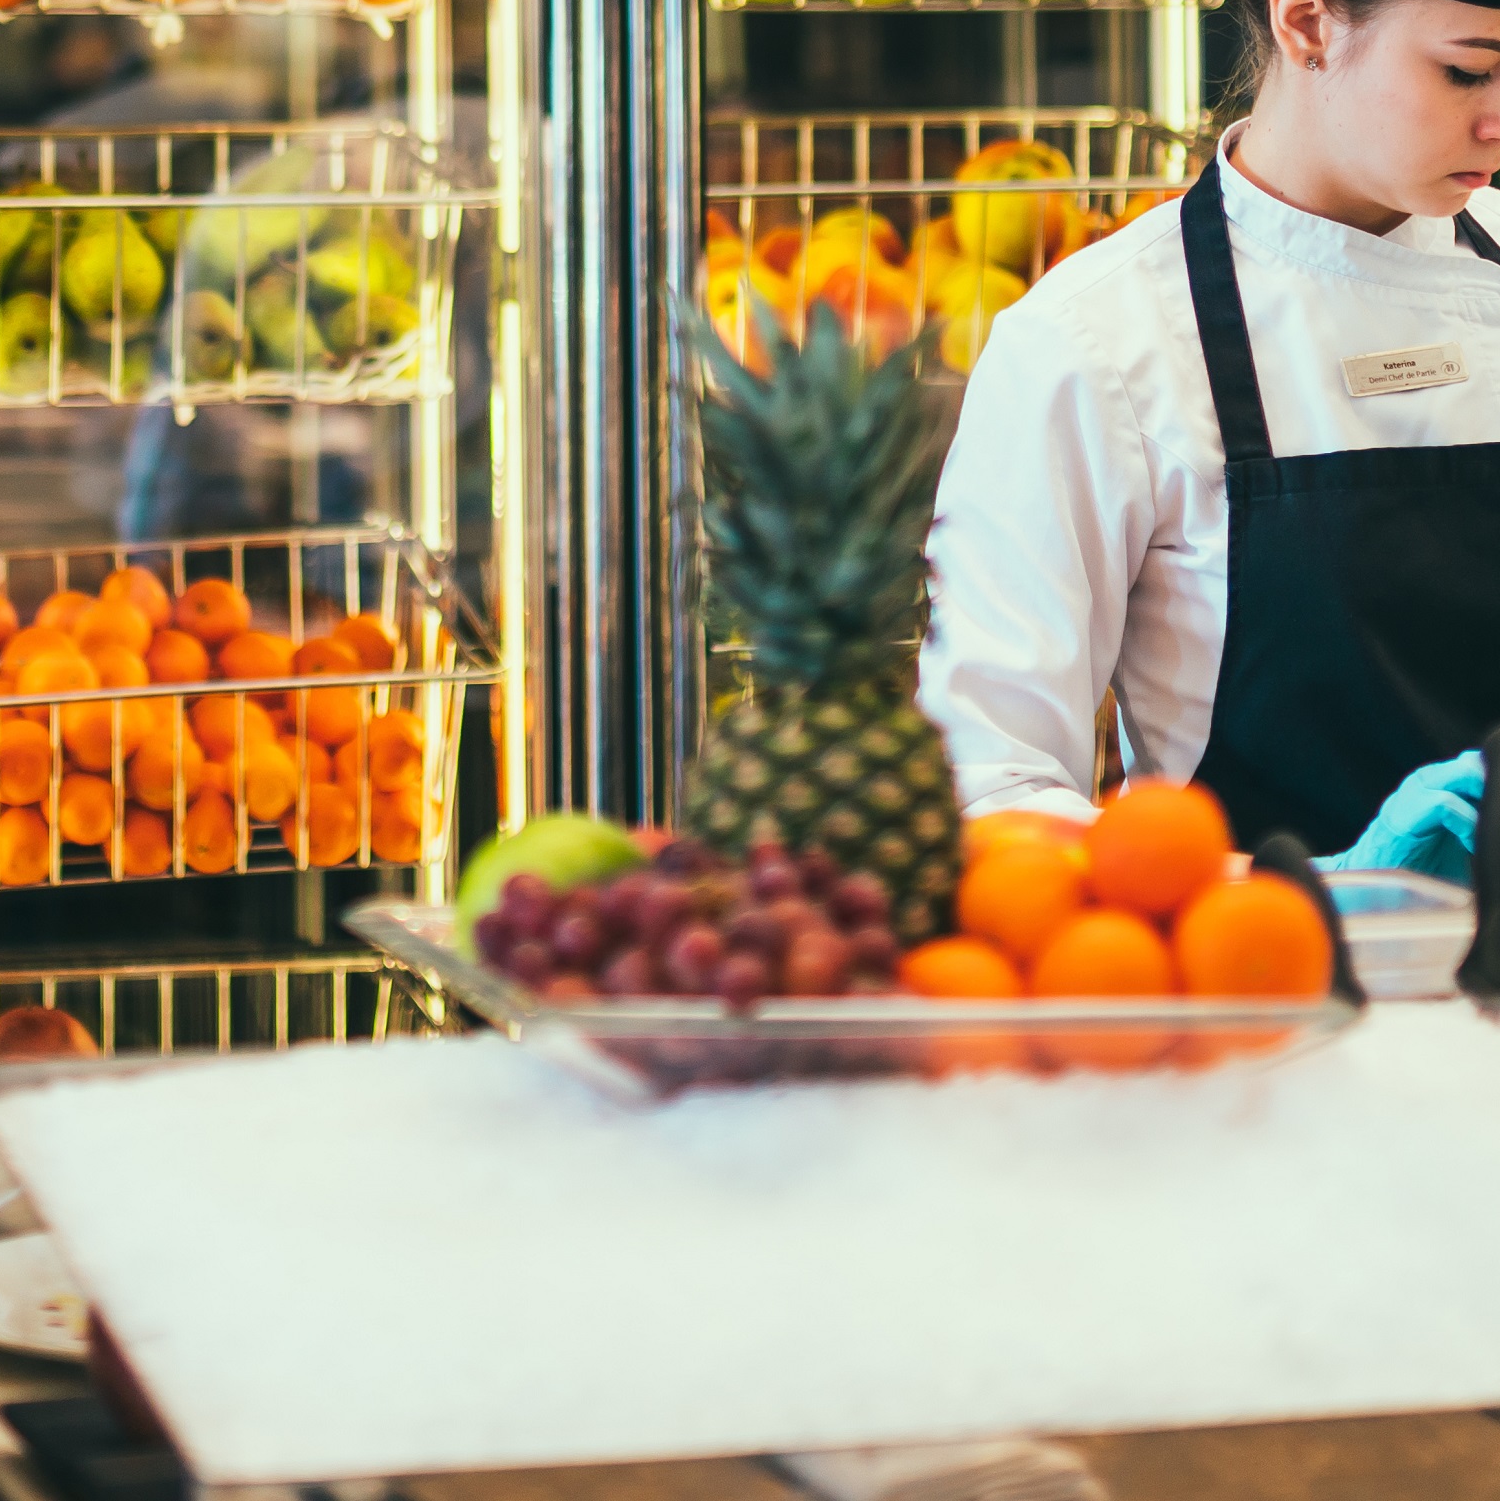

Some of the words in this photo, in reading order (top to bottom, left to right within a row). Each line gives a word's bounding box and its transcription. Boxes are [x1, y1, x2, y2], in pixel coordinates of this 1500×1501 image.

[1383, 360, 1416, 370] Katerina
[1368, 375, 1388, 384] Demi
[1388, 372, 1404, 382] Chef
[1416, 368, 1437, 377] Partie
